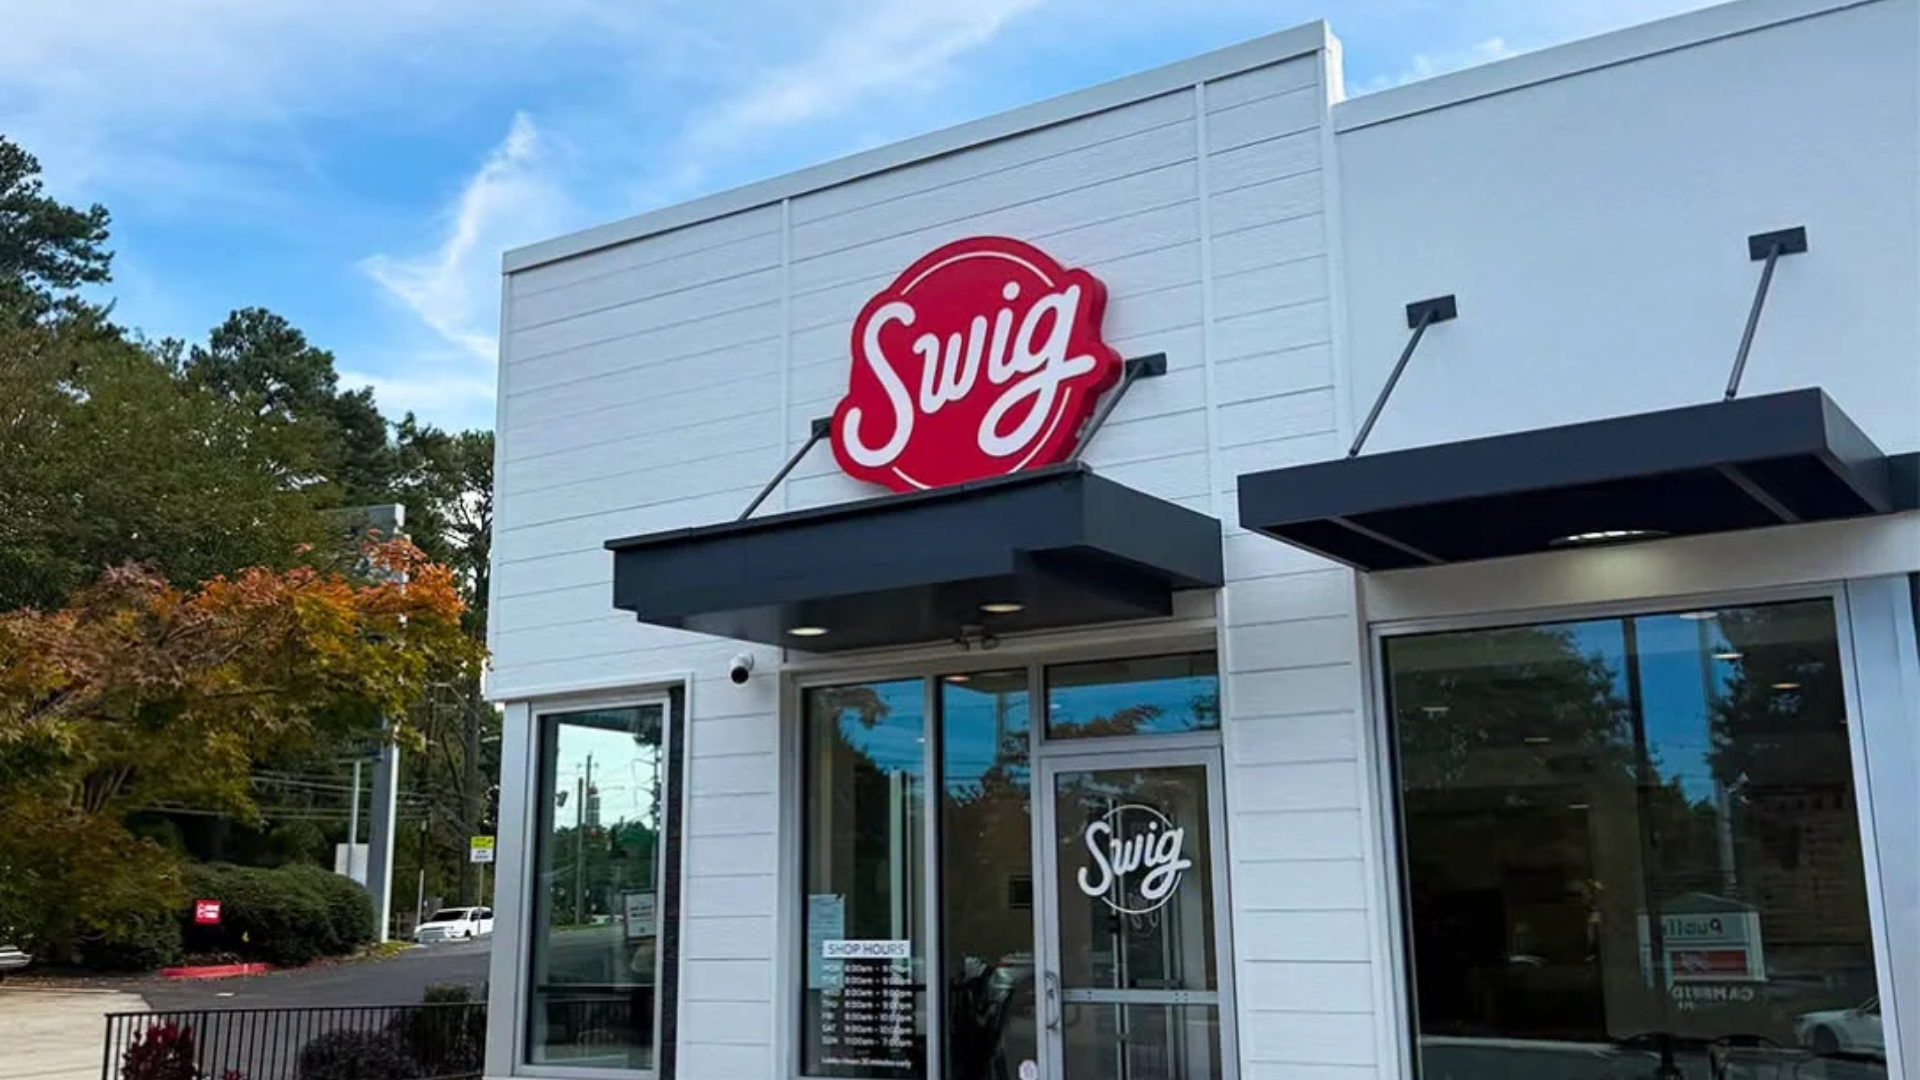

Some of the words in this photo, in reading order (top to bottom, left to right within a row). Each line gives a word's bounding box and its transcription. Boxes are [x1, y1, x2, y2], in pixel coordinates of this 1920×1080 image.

[843, 281, 1097, 467] Swig
[1078, 821, 1192, 900] Swig
[828, 943, 861, 956] SHOP
[863, 943, 905, 956] HOURS
